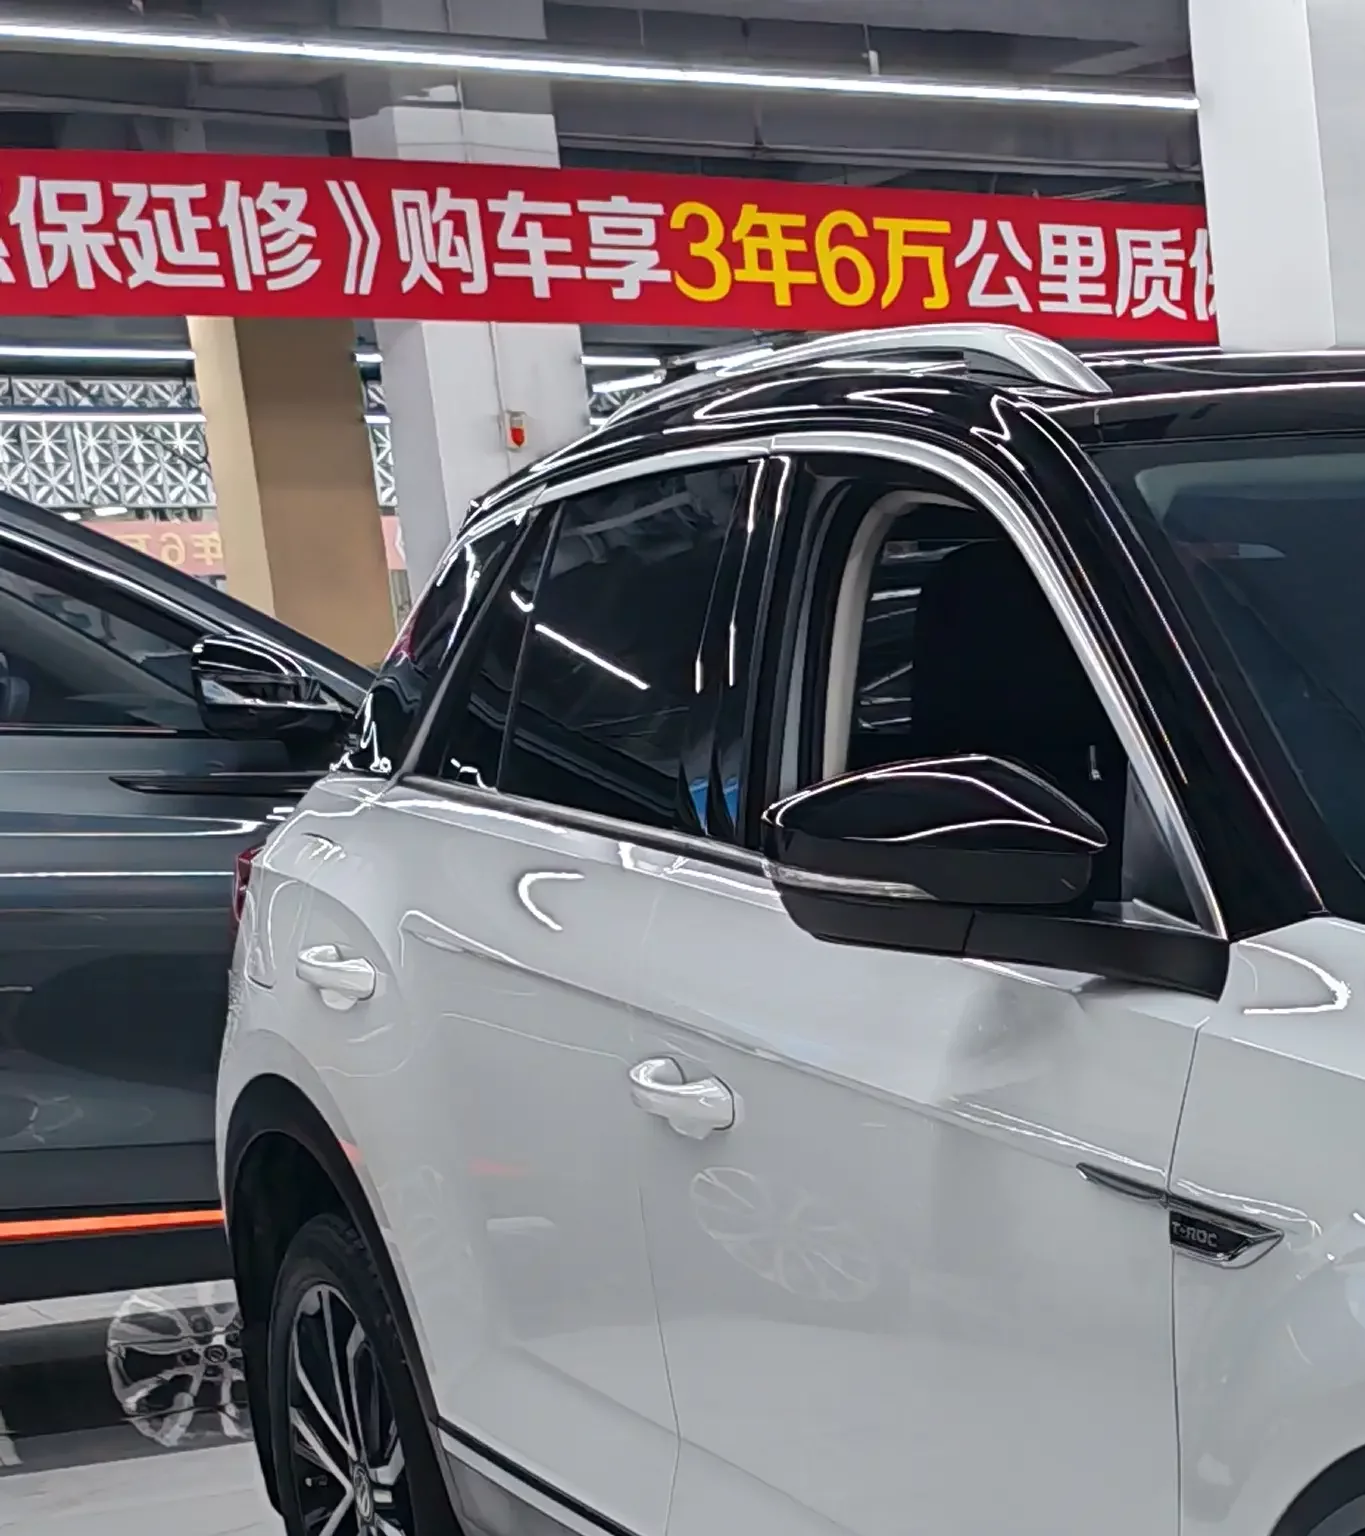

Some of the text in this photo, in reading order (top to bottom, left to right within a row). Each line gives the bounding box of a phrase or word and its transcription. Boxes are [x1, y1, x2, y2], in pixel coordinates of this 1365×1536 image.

[0, 175, 1217, 321] 保延修》购车享3年6万公里质
